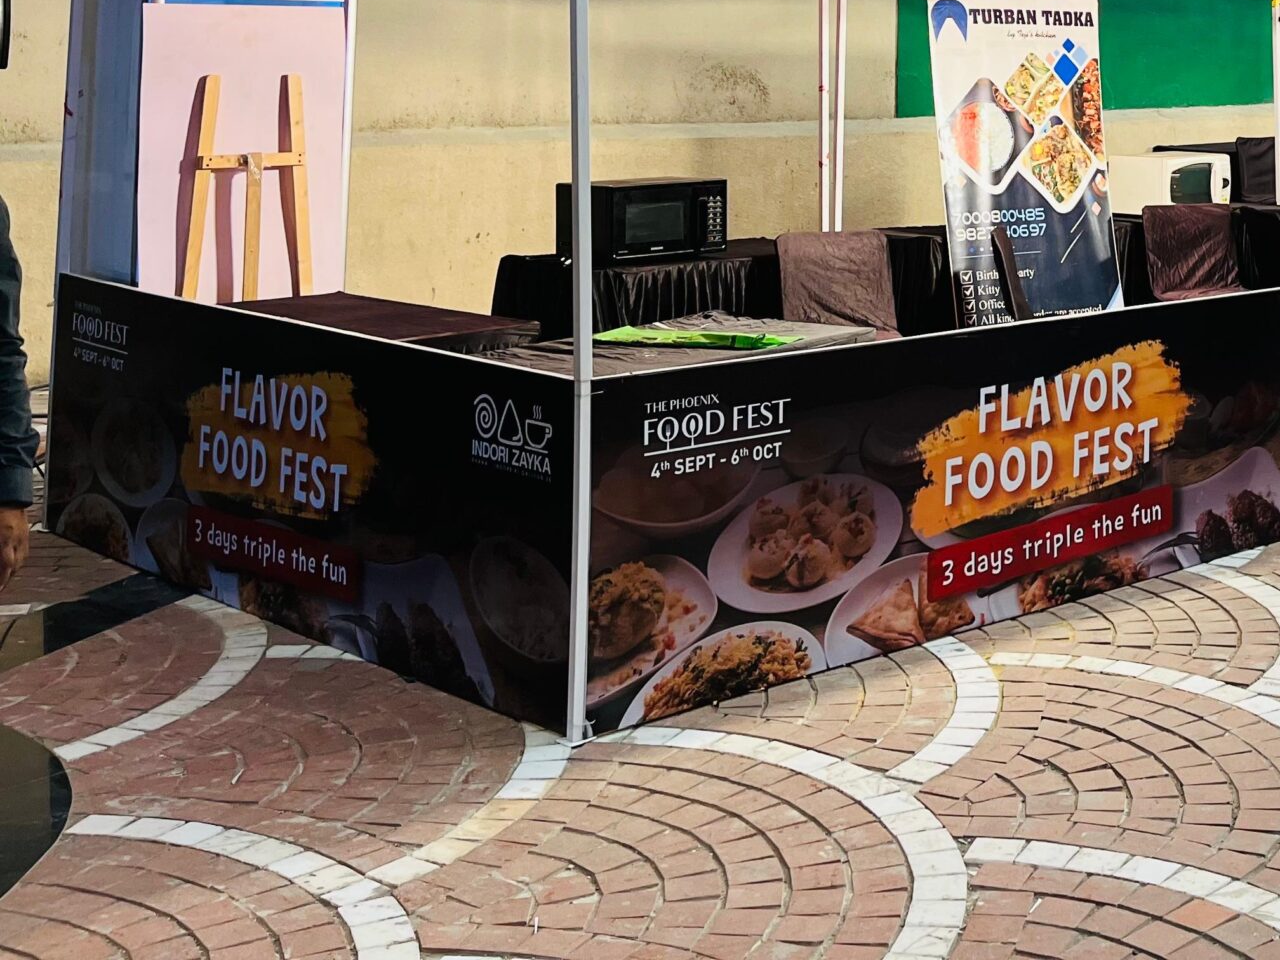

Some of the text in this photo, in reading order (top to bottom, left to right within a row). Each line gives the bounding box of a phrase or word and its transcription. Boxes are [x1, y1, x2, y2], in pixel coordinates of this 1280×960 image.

[969, 8, 1094, 27] TURBAN TADKA
[952, 208, 1046, 225] 7000800485
[977, 285, 1001, 297] Kitty
[1017, 268, 1035, 279] arty
[73, 312, 130, 346] FOOD FEST
[980, 315, 995, 326] All
[82, 349, 98, 364] SEPT
[112, 357, 124, 373] OCT
[220, 367, 328, 441] FLAVOR
[644, 394, 719, 414] THE PHOENIX
[977, 361, 1133, 434] FLAVOR
[644, 398, 792, 446] FOOD FEST
[199, 424, 348, 512] FOOD FEST
[472, 439, 509, 464] INDORI
[512, 449, 552, 475] ZAYKA
[650, 460, 671, 479] 4th
[674, 453, 716, 475] SEPT
[731, 446, 749, 465] 6th
[753, 442, 782, 460] OCT
[943, 417, 1159, 507] FOOD FEST
[195, 519, 347, 586] 3 days triple the fun
[942, 500, 1163, 587] 3 days triple the fun
